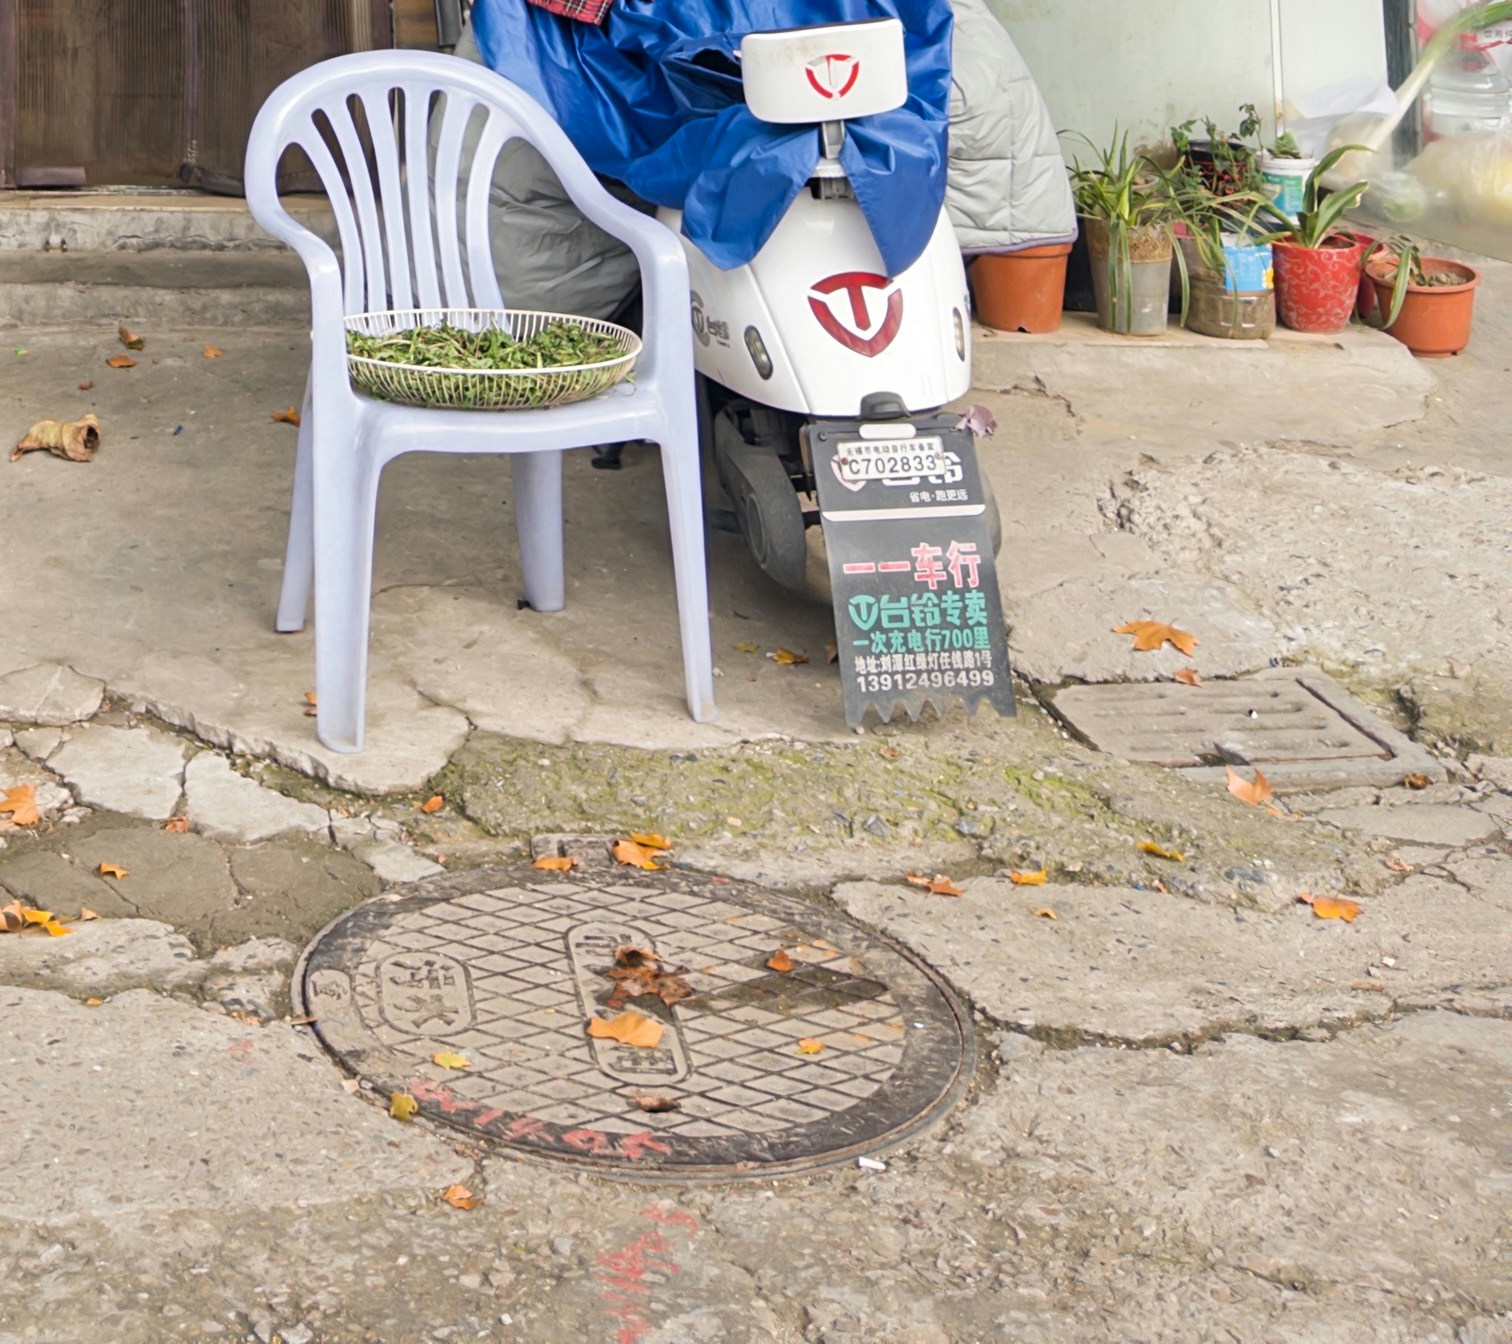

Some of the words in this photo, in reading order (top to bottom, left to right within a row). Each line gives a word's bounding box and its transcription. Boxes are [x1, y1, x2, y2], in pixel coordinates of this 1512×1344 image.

[848, 454, 937, 476] C702833
[853, 630, 991, 654] 一次充电行700里
[857, 670, 995, 693] 13912496499
